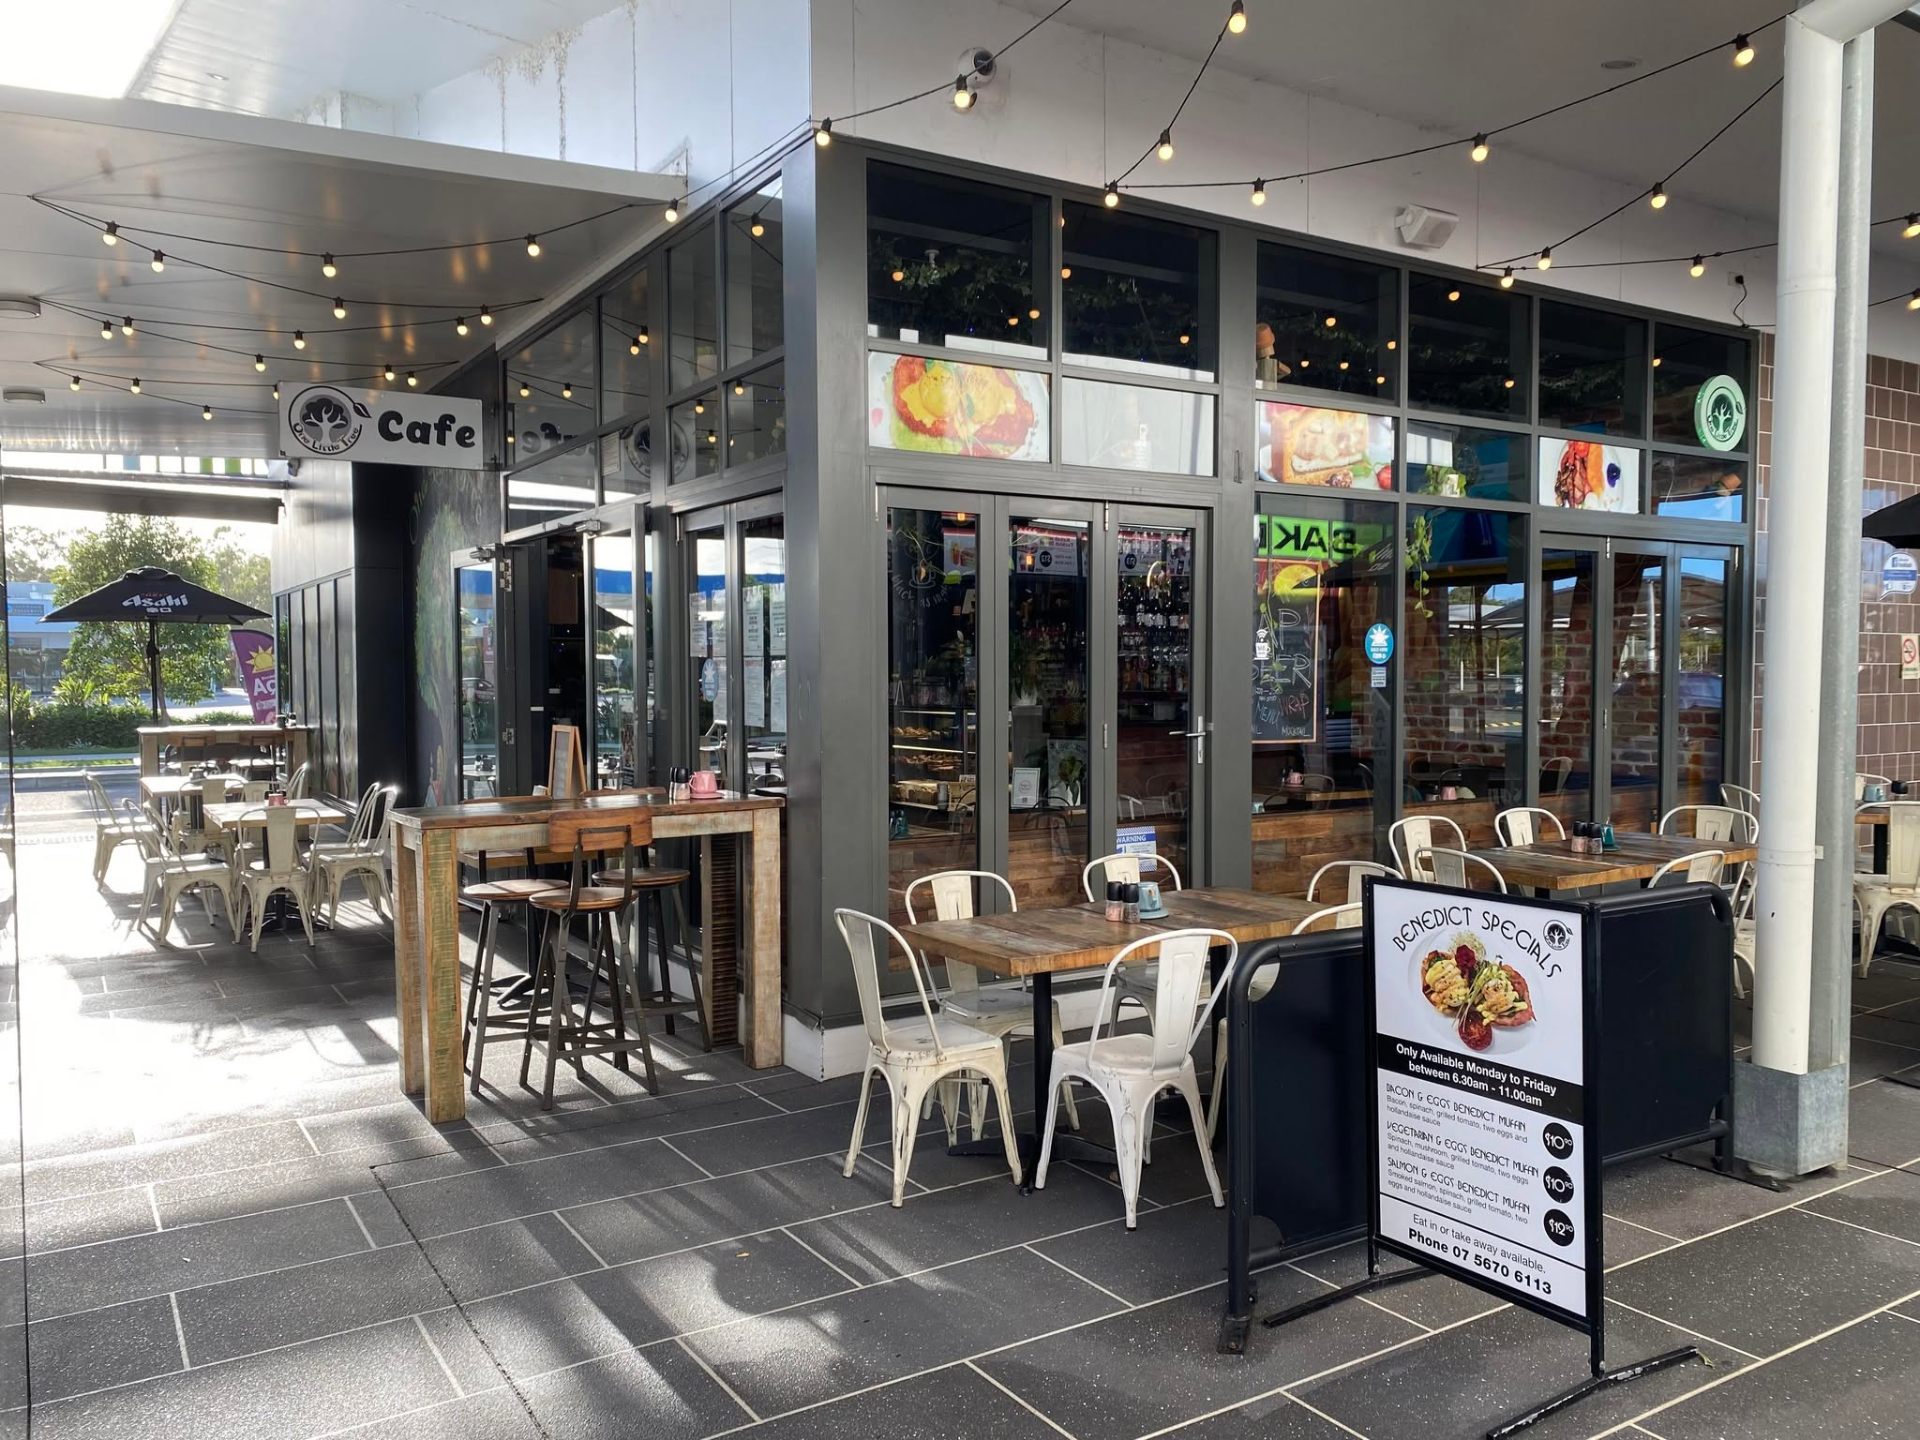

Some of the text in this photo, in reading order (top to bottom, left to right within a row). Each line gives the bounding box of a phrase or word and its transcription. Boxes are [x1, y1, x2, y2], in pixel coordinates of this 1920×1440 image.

[378, 409, 476, 448] Cafe
[122, 594, 188, 607] Asahi
[1392, 906, 1562, 978] BENEDICT SPECIALS
[1396, 1043, 1557, 1097] Only Available Monday to Friday
[1409, 1061, 1450, 1081] between
[1452, 1072, 1489, 1092] 6.30am
[1498, 1085, 1543, 1107] 11.00am
[1386, 1082, 1414, 1099] BACON
[1427, 1094, 1450, 1109] EGGS
[1453, 1101, 1495, 1122] BENEDICT
[1499, 1114, 1526, 1132] MUFFIN
[1483, 1124, 1495, 1134] two
[1496, 1130, 1513, 1140] eggs
[1514, 1134, 1528, 1144] and
[1444, 1138, 1467, 1154] EGGS
[1470, 1146, 1510, 1167] BENEDICT
[1512, 1160, 1539, 1178] MUFFIN
[1498, 1168, 1511, 1179] two
[1511, 1174, 1529, 1185] eggs
[1387, 1156, 1418, 1175] SALMON
[1430, 1171, 1454, 1188] EGGS
[1457, 1180, 1499, 1203] BENEDICT
[1502, 1196, 1530, 1215] MUFFIN
[1387, 1179, 1403, 1190] eggs
[1403, 1185, 1416, 1194] and
[1515, 1213, 1528, 1224] two
[1408, 1227, 1552, 1295] Phone 07 5670 6113
[1413, 1213, 1546, 1274] Eat in or take away available.
